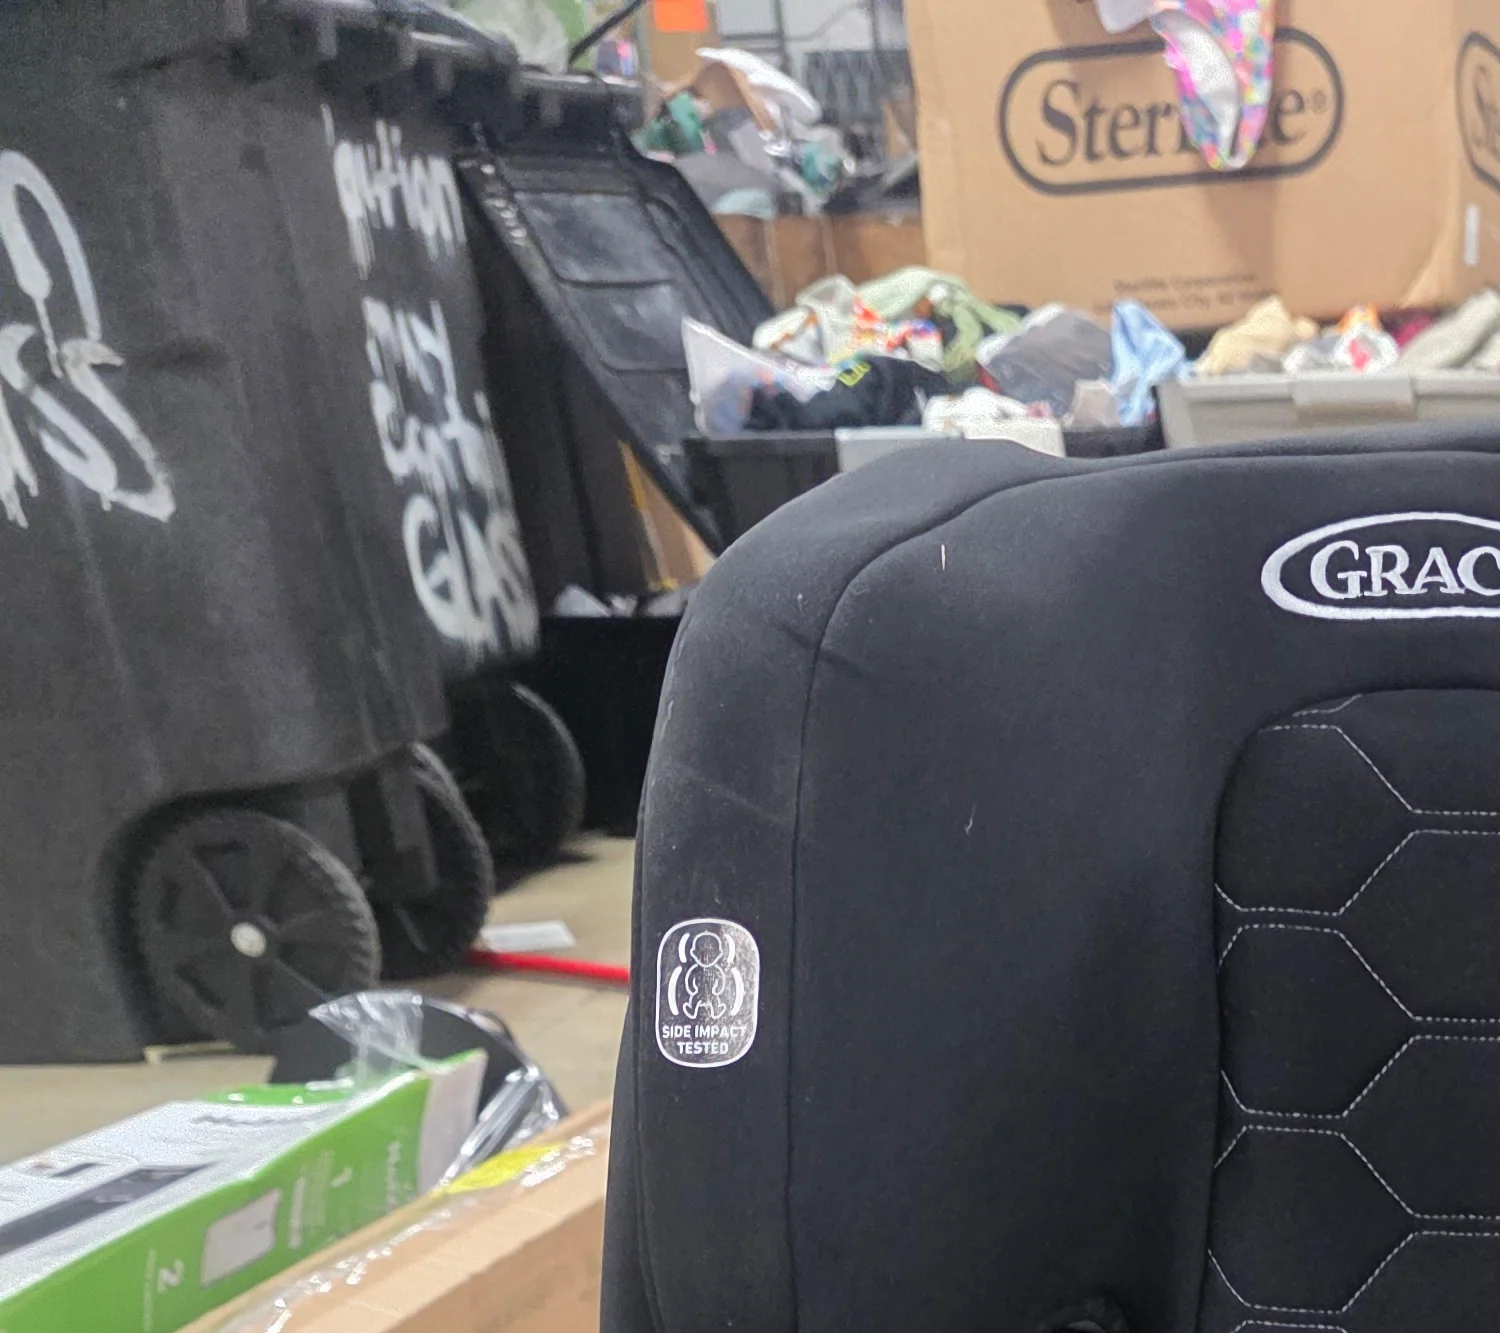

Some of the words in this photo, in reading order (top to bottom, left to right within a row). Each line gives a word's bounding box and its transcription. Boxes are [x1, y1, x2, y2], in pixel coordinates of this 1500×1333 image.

[1036, 78, 1308, 168] Stere
[662, 1025, 692, 1039] SIDE
[695, 1025, 747, 1039] IMPACT
[677, 1041, 729, 1055] TESTED
